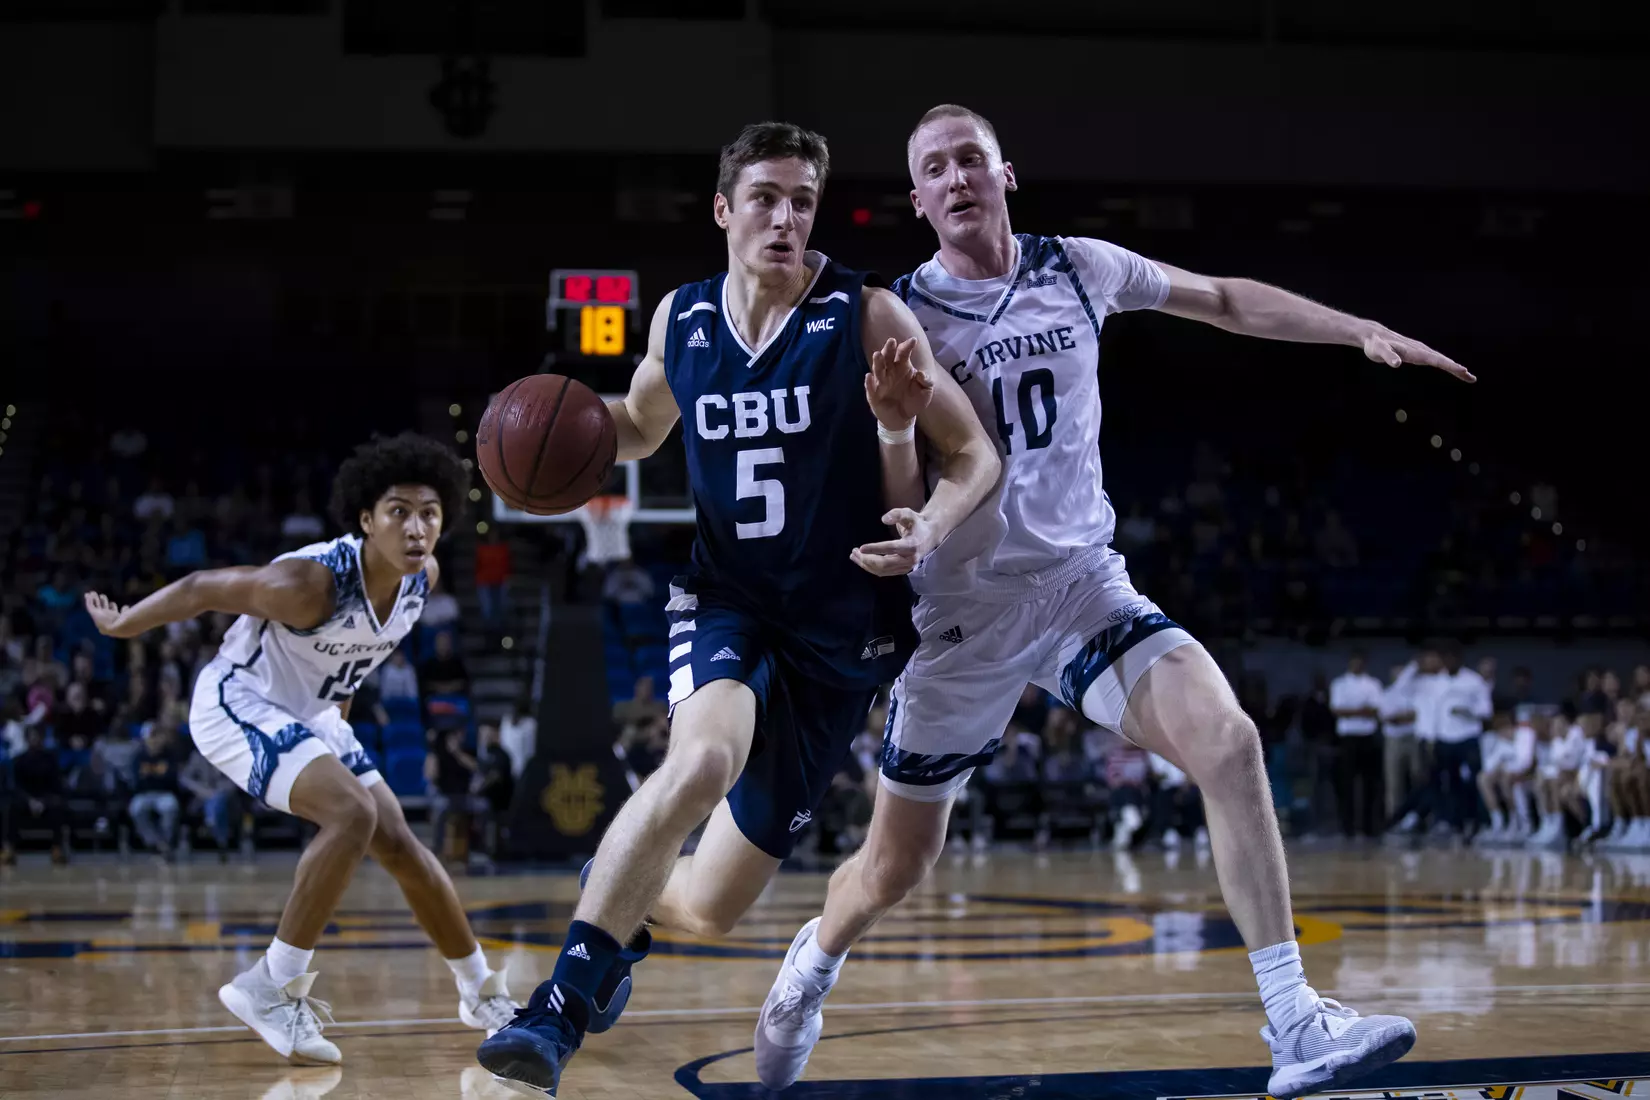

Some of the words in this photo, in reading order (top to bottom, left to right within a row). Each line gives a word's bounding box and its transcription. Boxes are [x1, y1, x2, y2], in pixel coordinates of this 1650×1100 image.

[581, 306, 625, 355] 18
[806, 317, 836, 334] WAC
[686, 339, 709, 347] adidas
[950, 360, 973, 386] C
[975, 327, 1076, 371] IRVINE
[695, 385, 812, 440] CBU
[735, 446, 786, 540] 5
[314, 641, 345, 656] UC
[344, 641, 396, 655] IRVIN
[710, 652, 741, 662] adidas
[567, 949, 591, 961] adidas
